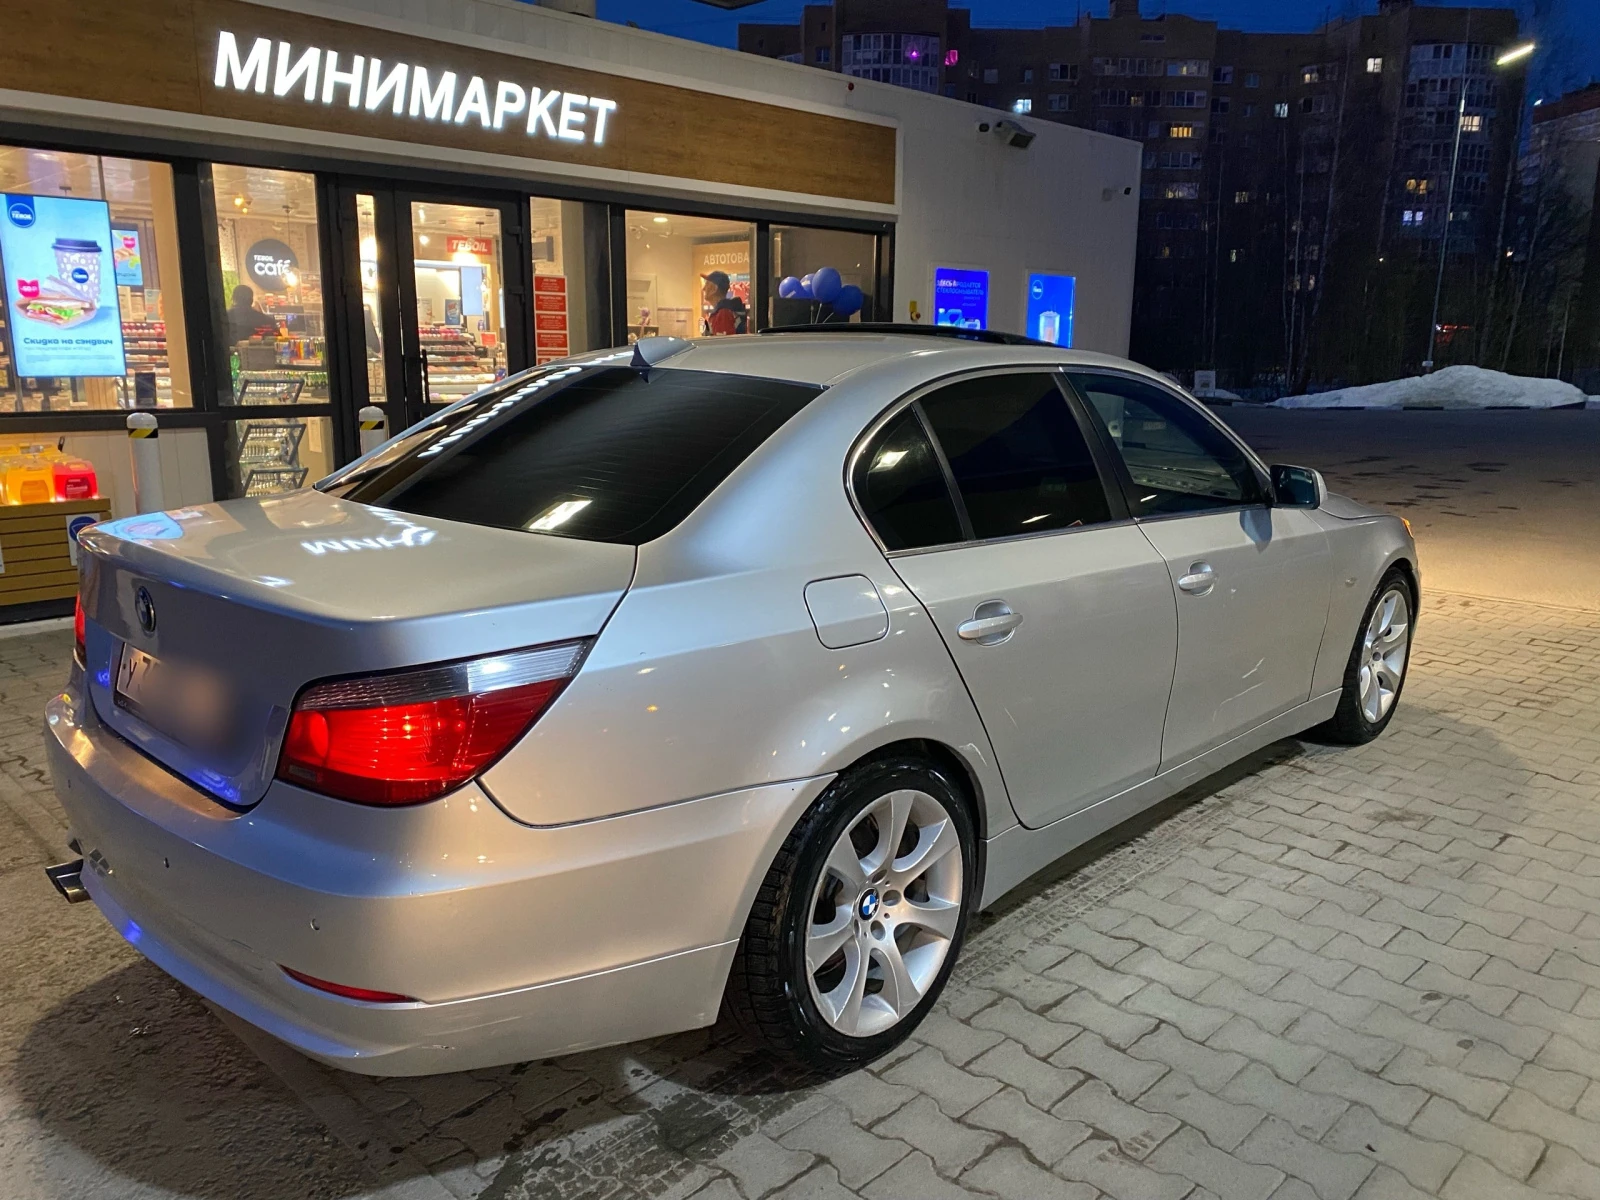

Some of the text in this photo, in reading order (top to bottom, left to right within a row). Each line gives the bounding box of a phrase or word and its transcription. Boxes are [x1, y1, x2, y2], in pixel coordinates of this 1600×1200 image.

[212, 30, 618, 145] МИНИМАРКЕТ
[451, 239, 489, 252] TEBOIL
[23, 337, 60, 346] Скидка
